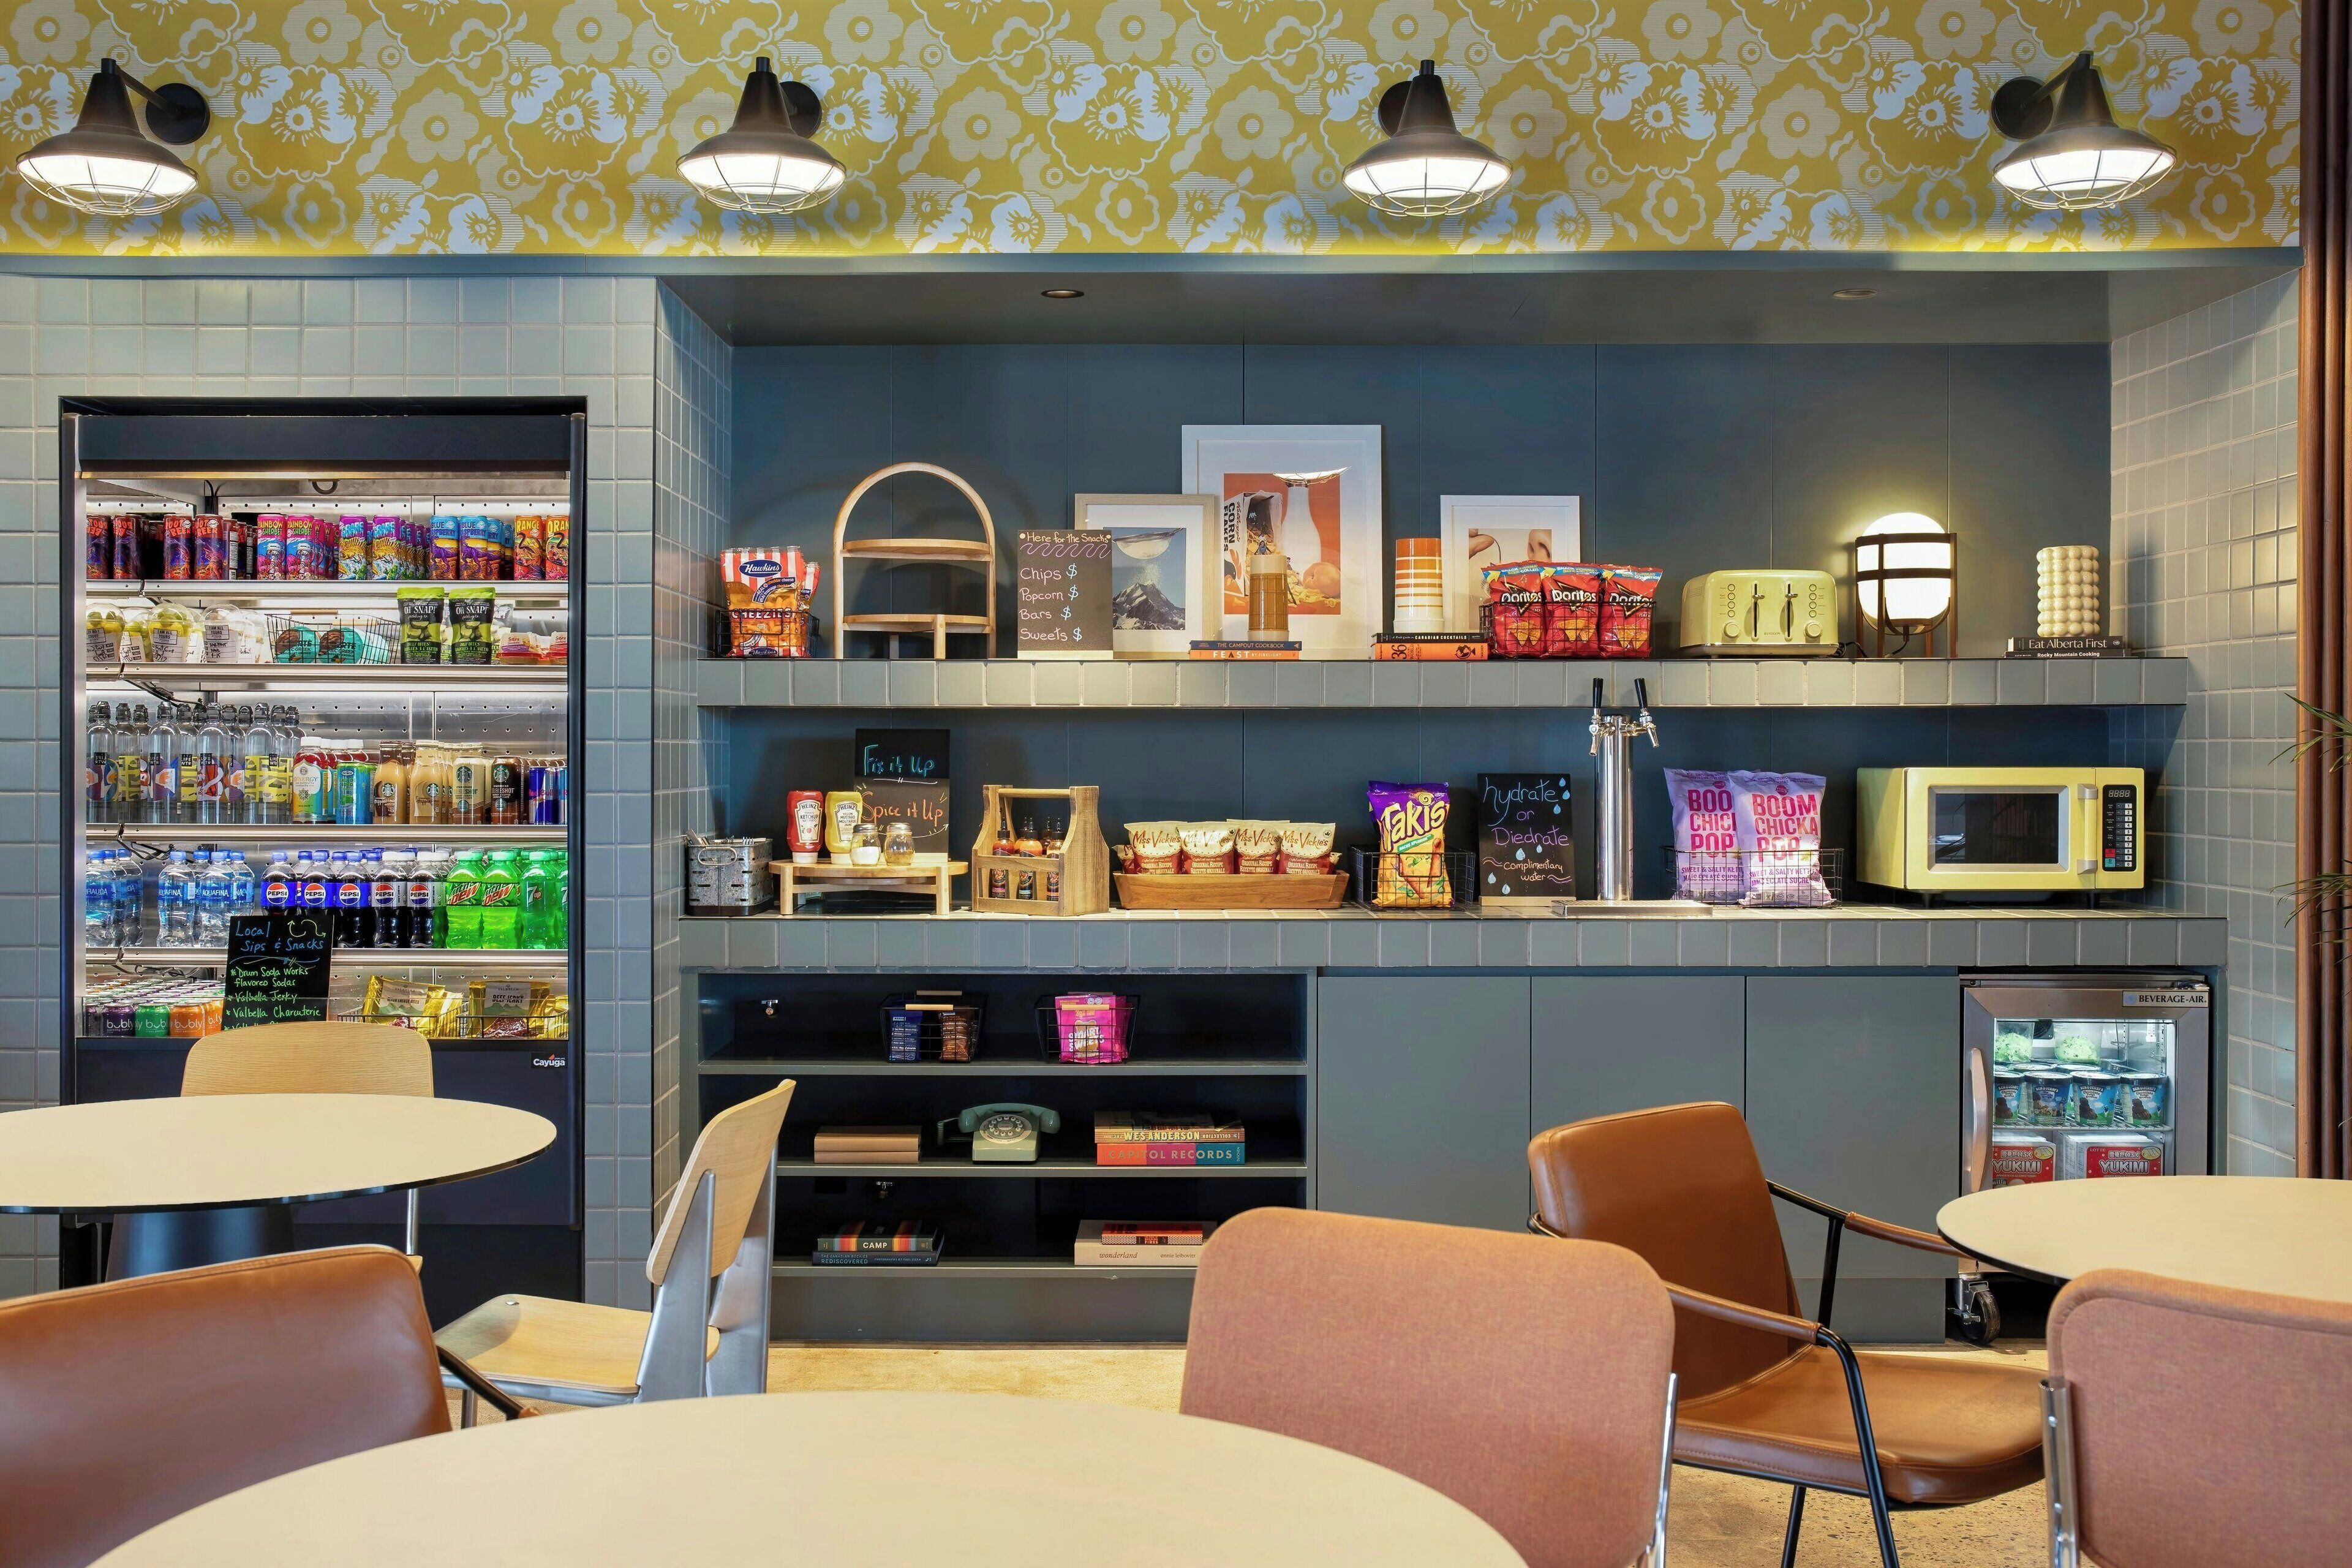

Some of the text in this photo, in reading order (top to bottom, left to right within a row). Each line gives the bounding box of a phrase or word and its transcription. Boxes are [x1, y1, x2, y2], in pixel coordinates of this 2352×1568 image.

[547, 521, 569, 534] ORAN
[1027, 532, 1051, 542] Here
[1053, 531, 1065, 543] for
[1082, 533, 1109, 544] Snacks
[742, 562, 780, 574] Hawkins
[1020, 562, 1077, 585] Chips $
[1019, 584, 1079, 604] Popcorn $
[1552, 589, 1596, 602] Doritos
[414, 605, 436, 614] SNAP!
[466, 605, 489, 614] SNAP!
[731, 608, 792, 619] CHEEZIES
[1019, 605, 1071, 621] Bars $
[1019, 627, 1082, 642] Sweets $
[2029, 638, 2107, 649] Eat Alberta First
[1391, 644, 1408, 660] 36
[864, 744, 884, 775] Fix
[910, 755, 935, 778] Up
[1482, 777, 1559, 827] hydrate
[1687, 789, 1733, 813] BOO
[1752, 793, 1819, 818] BOOM
[861, 791, 943, 827] Spice it Up
[1517, 810, 1535, 821] or
[1380, 792, 1446, 853] Takis
[1689, 813, 1736, 832] CHIC
[1754, 816, 1819, 836] CHICKA
[1299, 832, 1329, 850] Vickie's
[1491, 825, 1569, 846] Diedrate
[1691, 832, 1734, 859] POP
[1756, 836, 1800, 862] POP
[1520, 872, 1546, 882] water
[202, 889, 229, 897] AQUAFINA
[235, 920, 271, 938] Local
[241, 940, 266, 953] Sips
[285, 938, 324, 951] Snacks
[236, 966, 258, 978] Drum
[260, 967, 281, 977] Soda
[273, 978, 296, 987] Sodas
[235, 990, 298, 1004] Valbella Jerky
[2139, 995, 2205, 1003] BEVERAGE-AIR
[233, 1006, 268, 1019] Valbella
[175, 1019, 203, 1030] bubly
[533, 1058, 565, 1068] Cayuga
[1124, 1131, 1146, 1141] WES
[1148, 1131, 1200, 1141] ANDERSON
[1108, 1150, 1232, 1159] CAPITOL RECORDS
[1992, 1158, 2042, 1174] YUKIMI
[2099, 1159, 2150, 1174] YUKIMI
